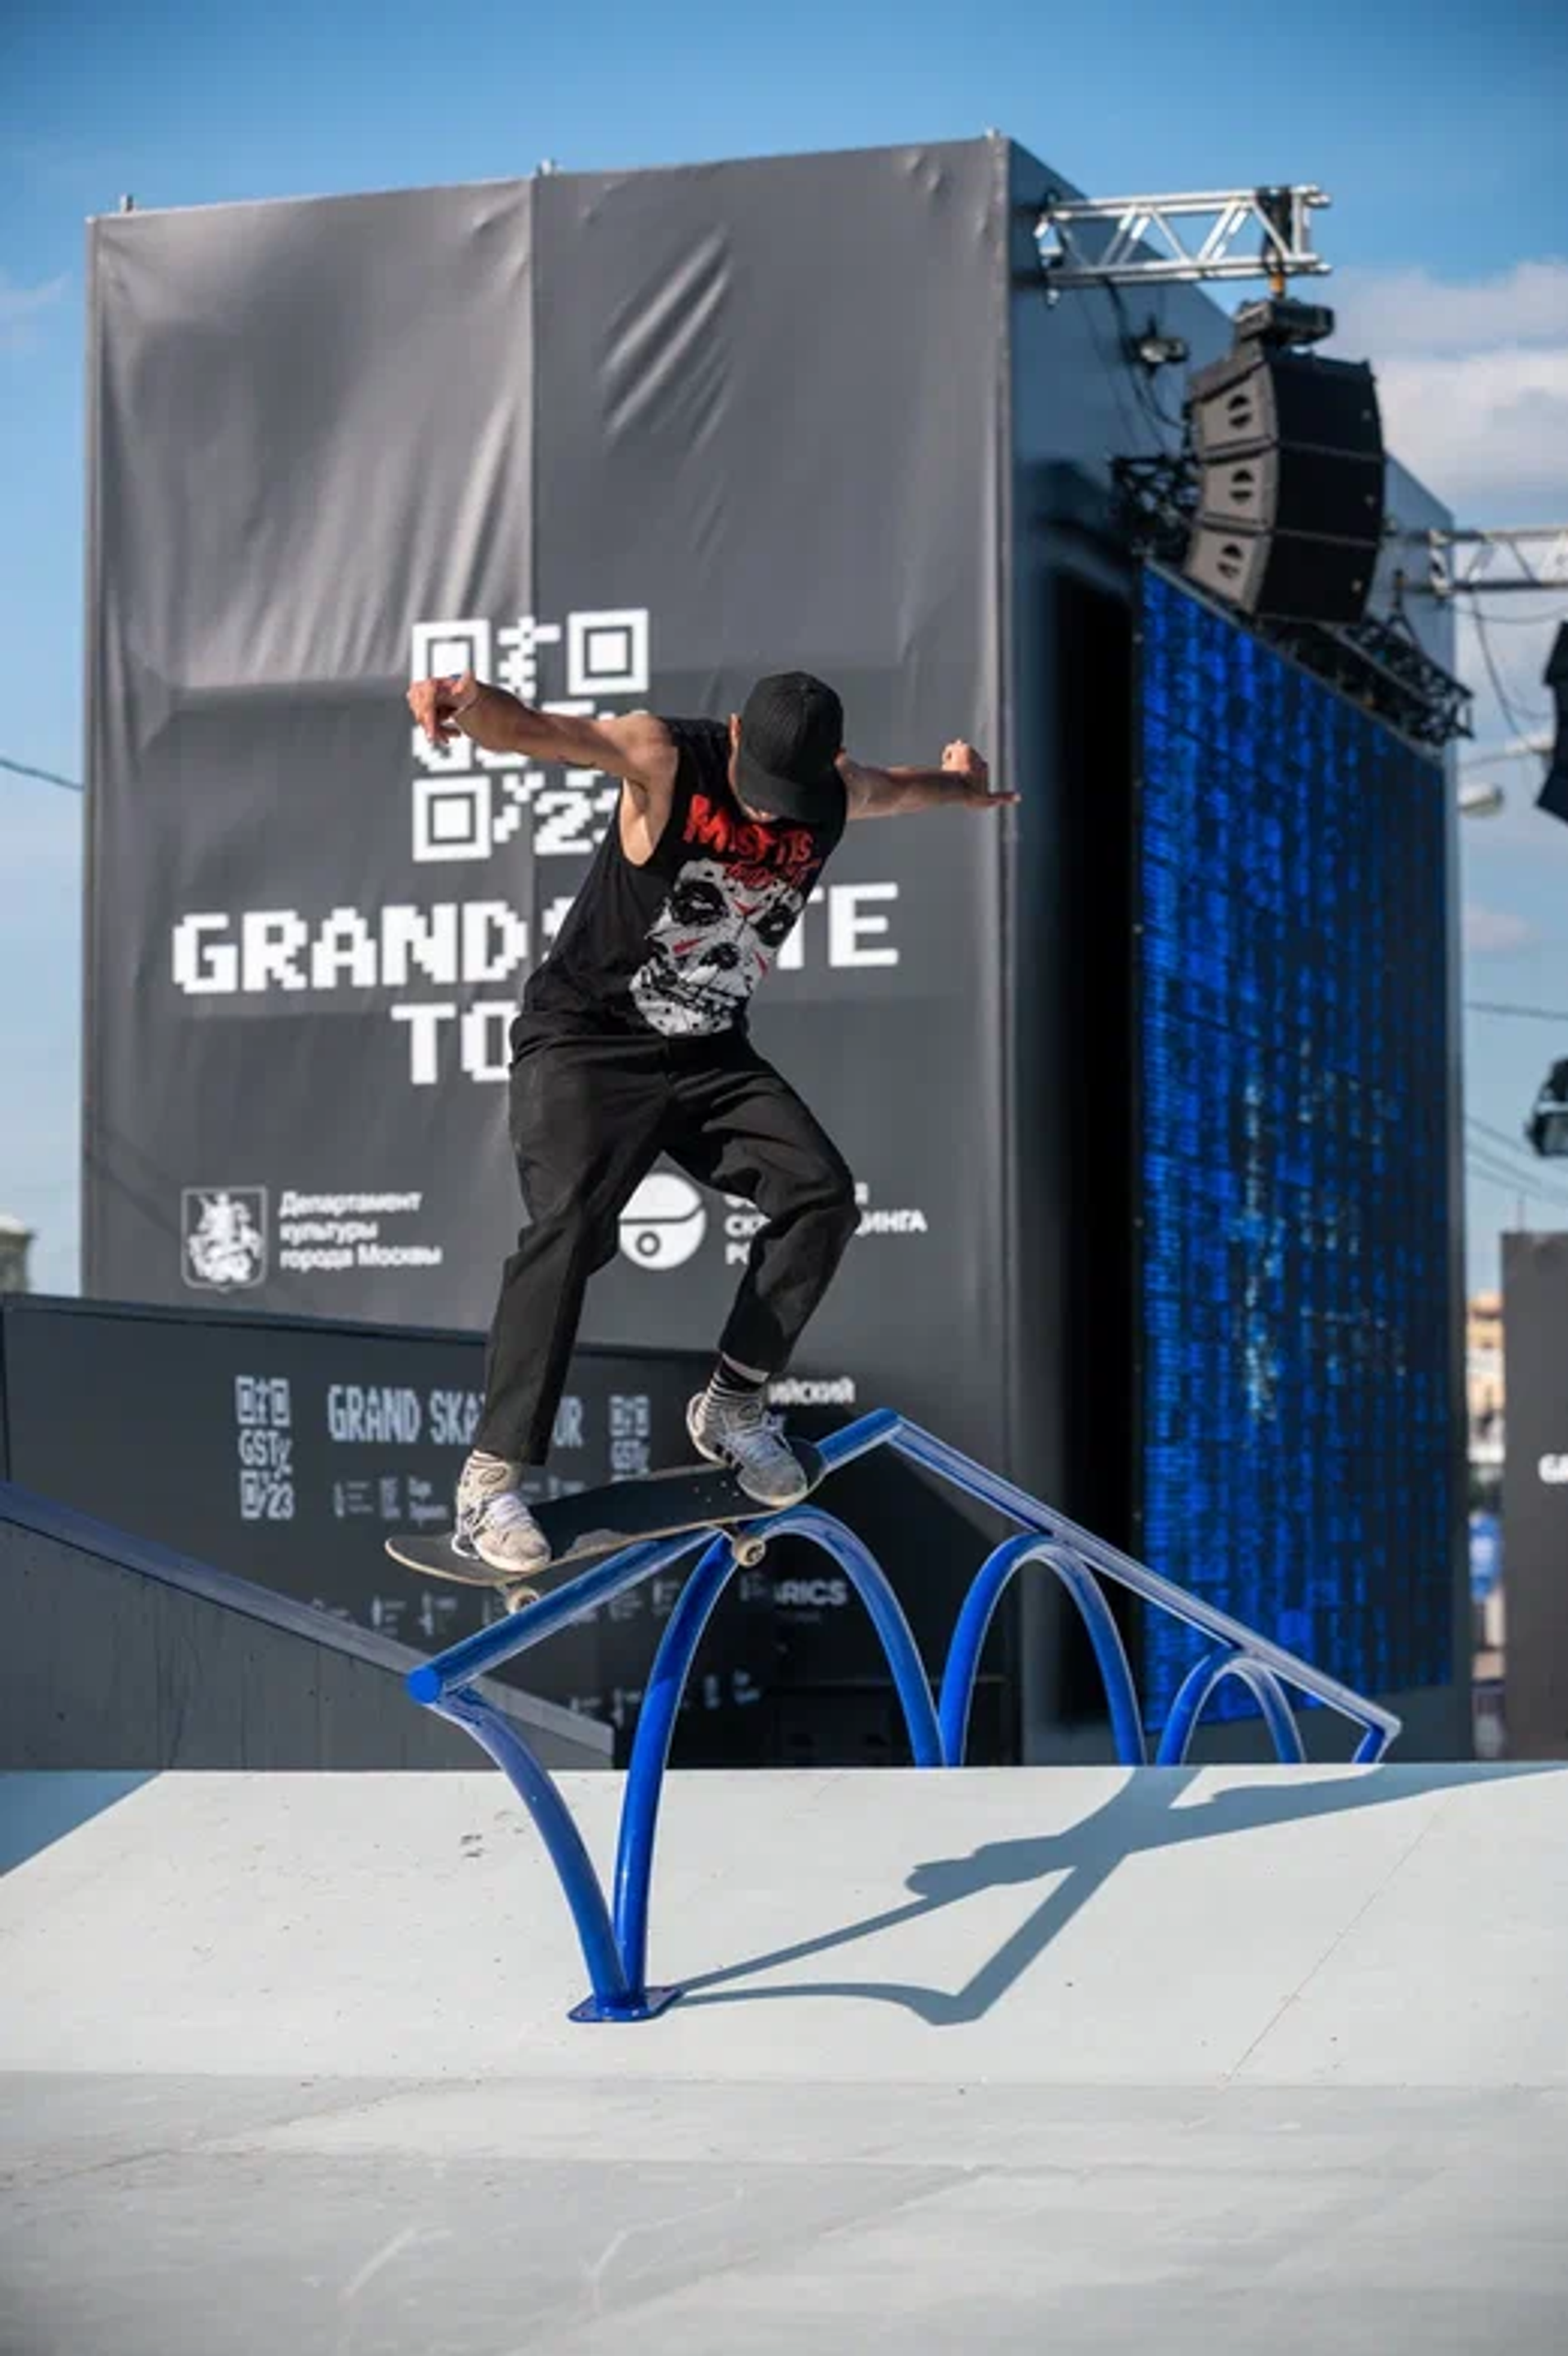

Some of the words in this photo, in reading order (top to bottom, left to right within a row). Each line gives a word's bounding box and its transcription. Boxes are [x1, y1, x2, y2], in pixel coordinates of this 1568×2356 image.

[172, 900, 528, 994] GRAND
[390, 1001, 520, 1084] TO
[328, 1384, 422, 1444] GRAND
[430, 1388, 486, 1446] SKA
